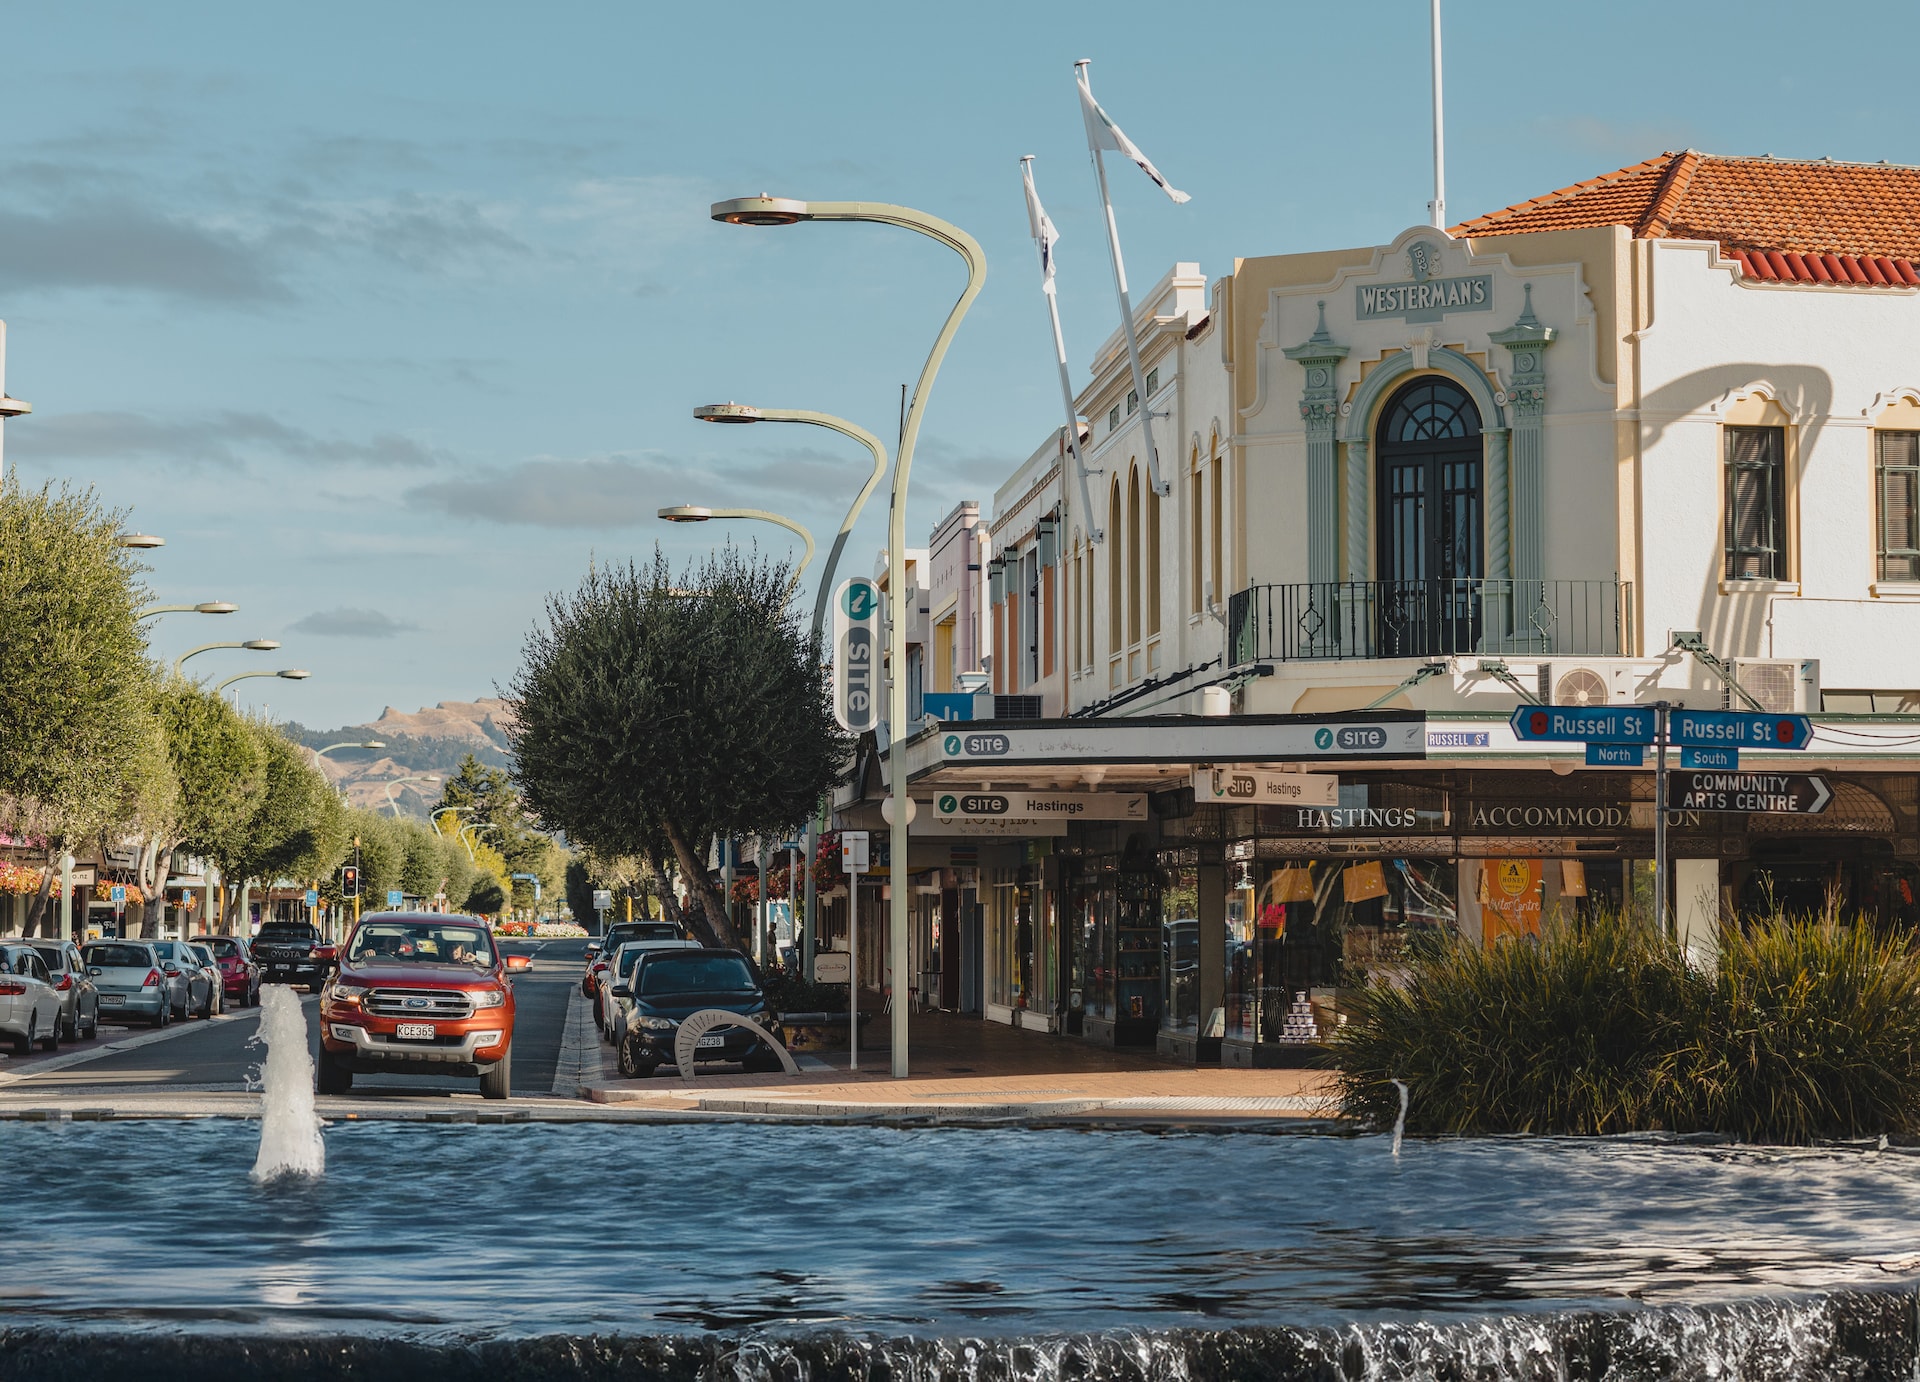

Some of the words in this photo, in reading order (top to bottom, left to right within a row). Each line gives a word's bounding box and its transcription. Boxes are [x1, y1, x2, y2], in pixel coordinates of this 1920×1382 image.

[1413, 246, 1428, 272] 1932
[1361, 279, 1485, 314] WESTERMAN'S
[1553, 715, 1616, 735] Russell
[1624, 716, 1643, 736] St
[1682, 719, 1745, 740] Russell
[1752, 721, 1772, 741] St
[1429, 734, 1469, 746] RUSSELL
[1598, 748, 1631, 761] North
[1693, 751, 1728, 765] South
[1266, 781, 1302, 798] Hastings
[1692, 774, 1789, 792] COMMUNITY
[1026, 799, 1084, 814] Hastings
[1683, 793, 1728, 809] ARTS
[1736, 794, 1799, 811] CENTRE
[1297, 807, 1417, 828] HASTINGS
[1472, 806, 1701, 828] ACCOMMODATON
[1508, 864, 1519, 876] A
[1265, 903, 1286, 916] AM
[1488, 898, 1514, 911] Visitor
[1513, 898, 1541, 912] Centre
[271, 950, 301, 958] OYOTA
[398, 1026, 434, 1037] KCE365
